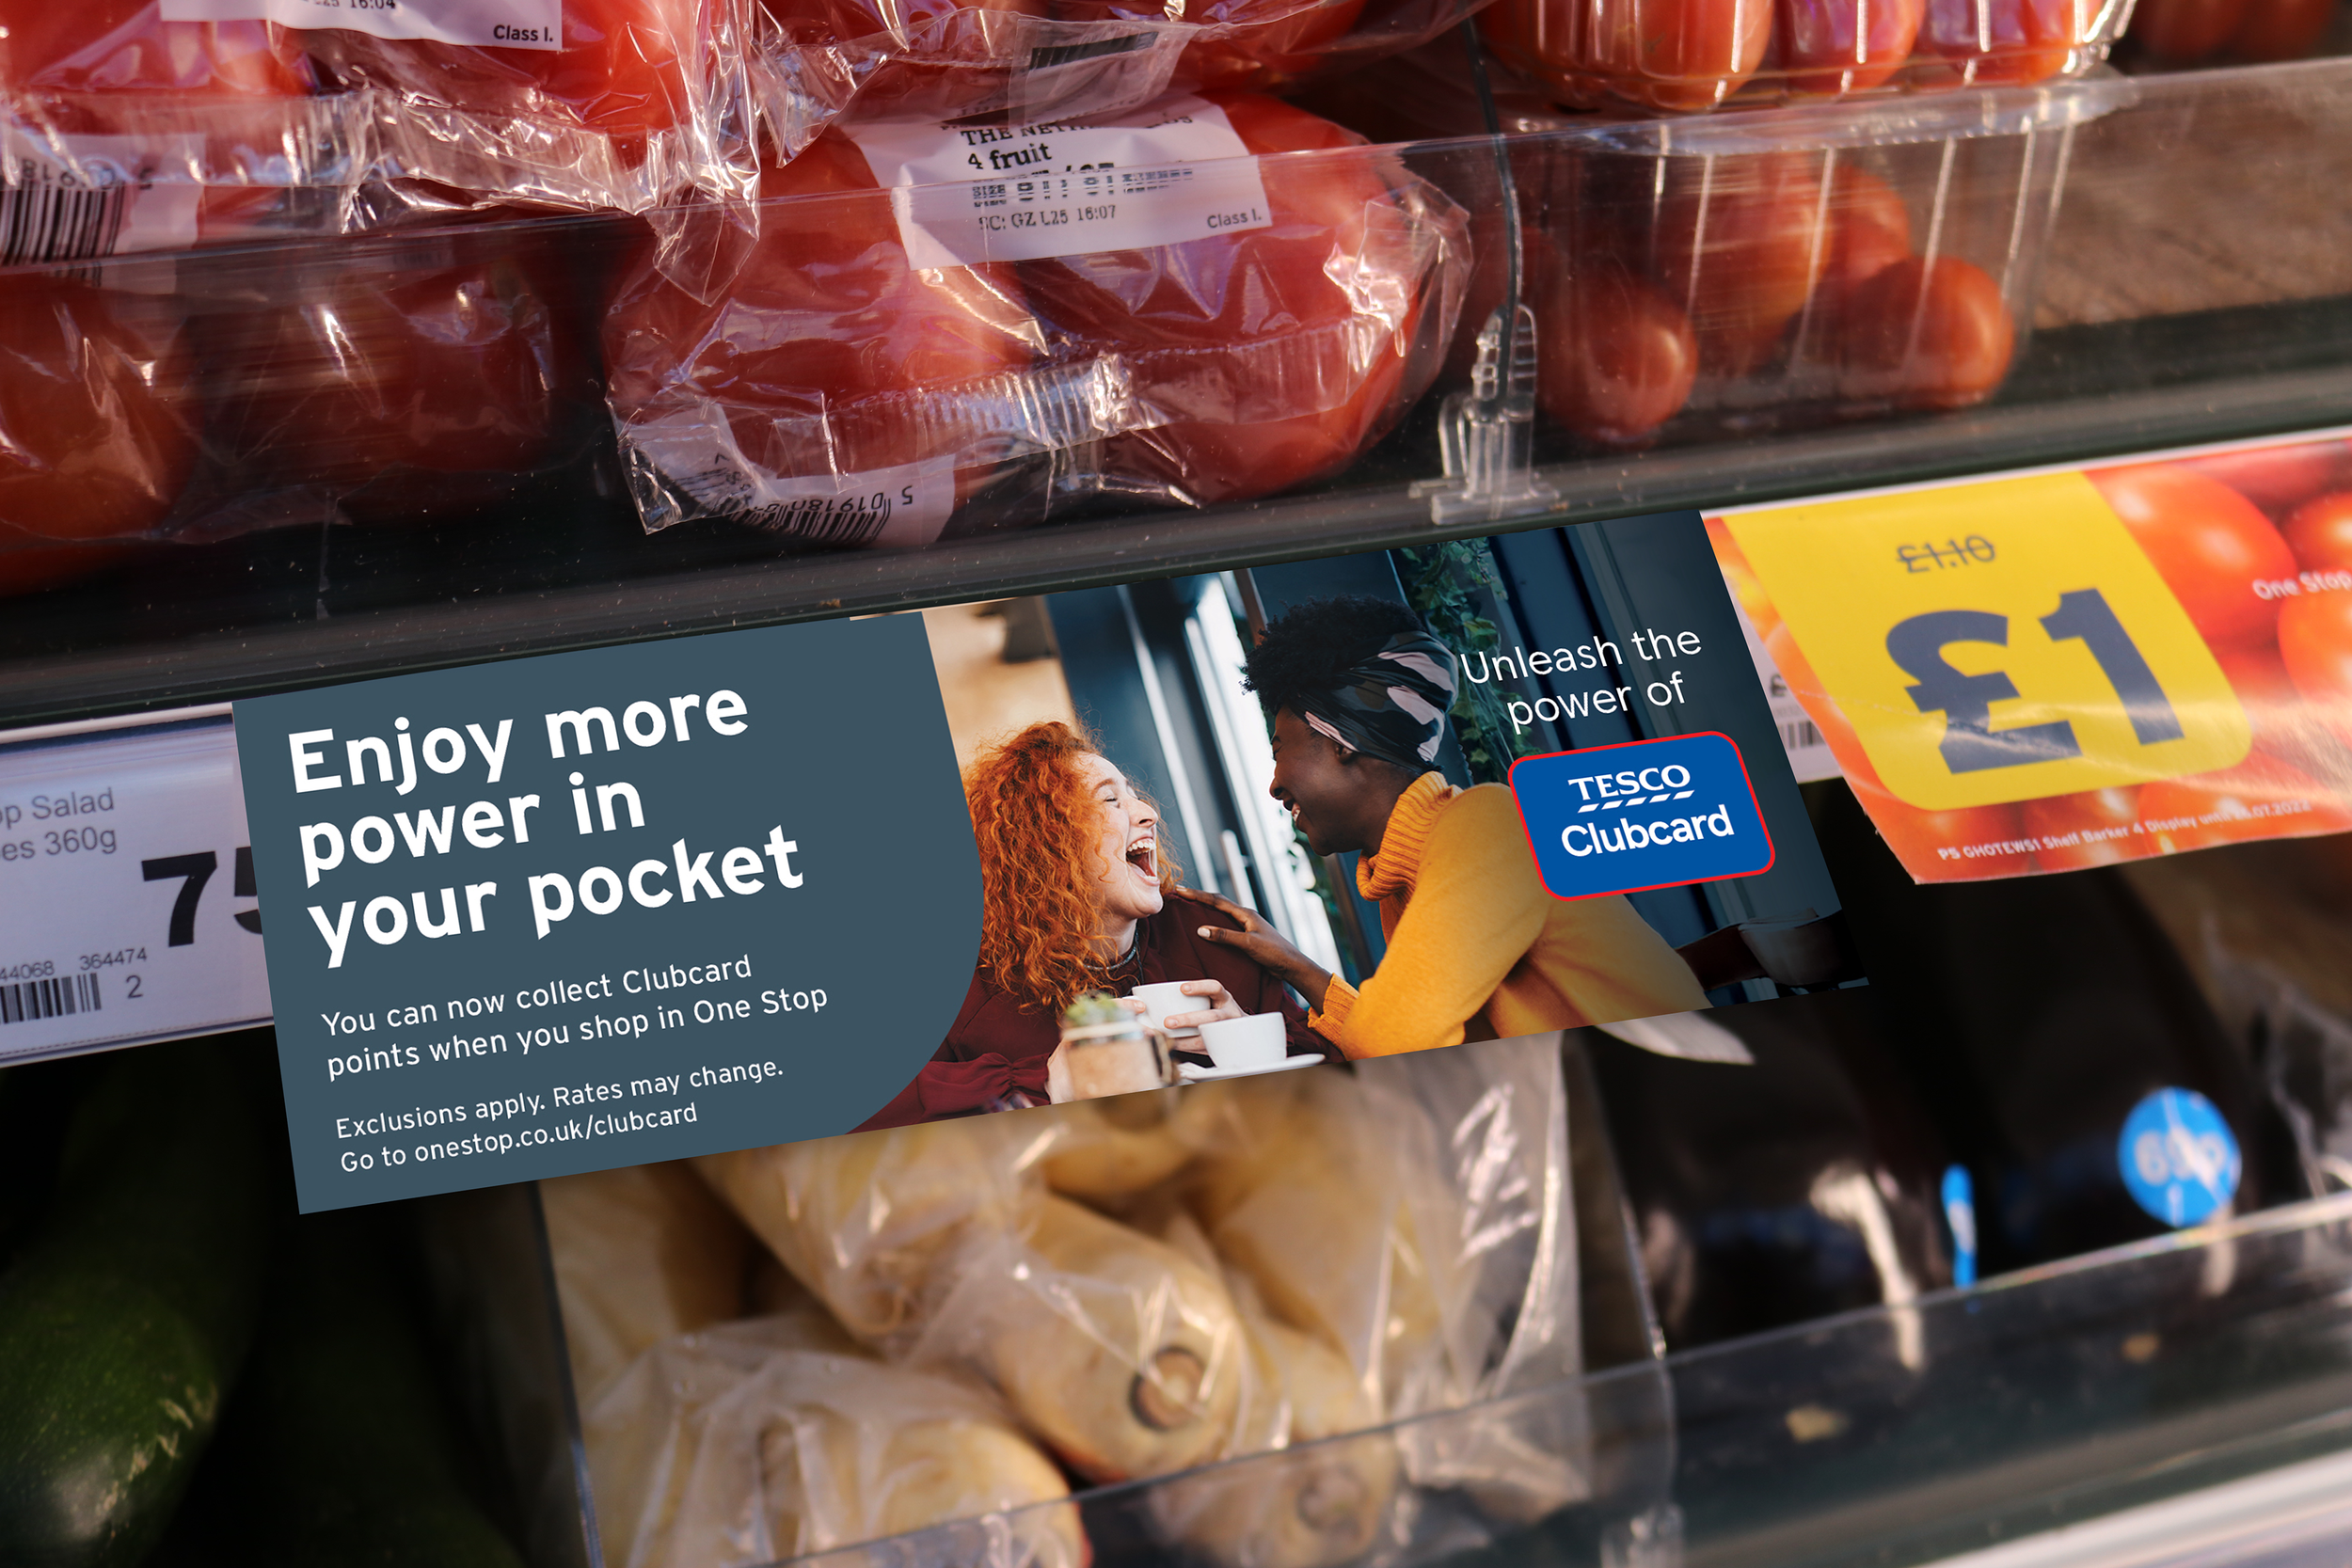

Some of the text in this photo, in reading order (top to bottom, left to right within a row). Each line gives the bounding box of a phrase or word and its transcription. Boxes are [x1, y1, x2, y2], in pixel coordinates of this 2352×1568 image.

[493, 24, 539, 42] Class
[961, 128, 1013, 147] THE
[968, 142, 1053, 170] 4 fruit
[1076, 204, 1117, 222] 16:07
[1207, 212, 1249, 230] Class
[1896, 534, 1996, 574] £1.10
[2251, 569, 2352, 601] One Stop
[1460, 628, 1702, 684] Unleash the
[1884, 587, 2187, 776] £1
[1507, 671, 1686, 736] power of
[289, 690, 748, 795] Enjoy more
[1567, 764, 1692, 801] TESCO
[31, 787, 115, 819] Salad
[1, 826, 118, 862] es 360g
[300, 772, 644, 888] power in
[1561, 804, 1735, 857] Clubcard
[2042, 831, 2081, 850] Shelf
[2080, 825, 2129, 844] Barker
[2144, 815, 2199, 833] Display
[308, 825, 803, 968] your pocket
[79, 946, 148, 971] 364474
[125, 974, 143, 999] 2
[322, 955, 752, 1037] You can now collect Clubcard
[327, 989, 828, 1083] points when you shop in One Stop
[336, 1062, 784, 1139] Exclusions apply. Rates may change.
[341, 1101, 698, 1172] Go to onestop.co.uk/clubcard
